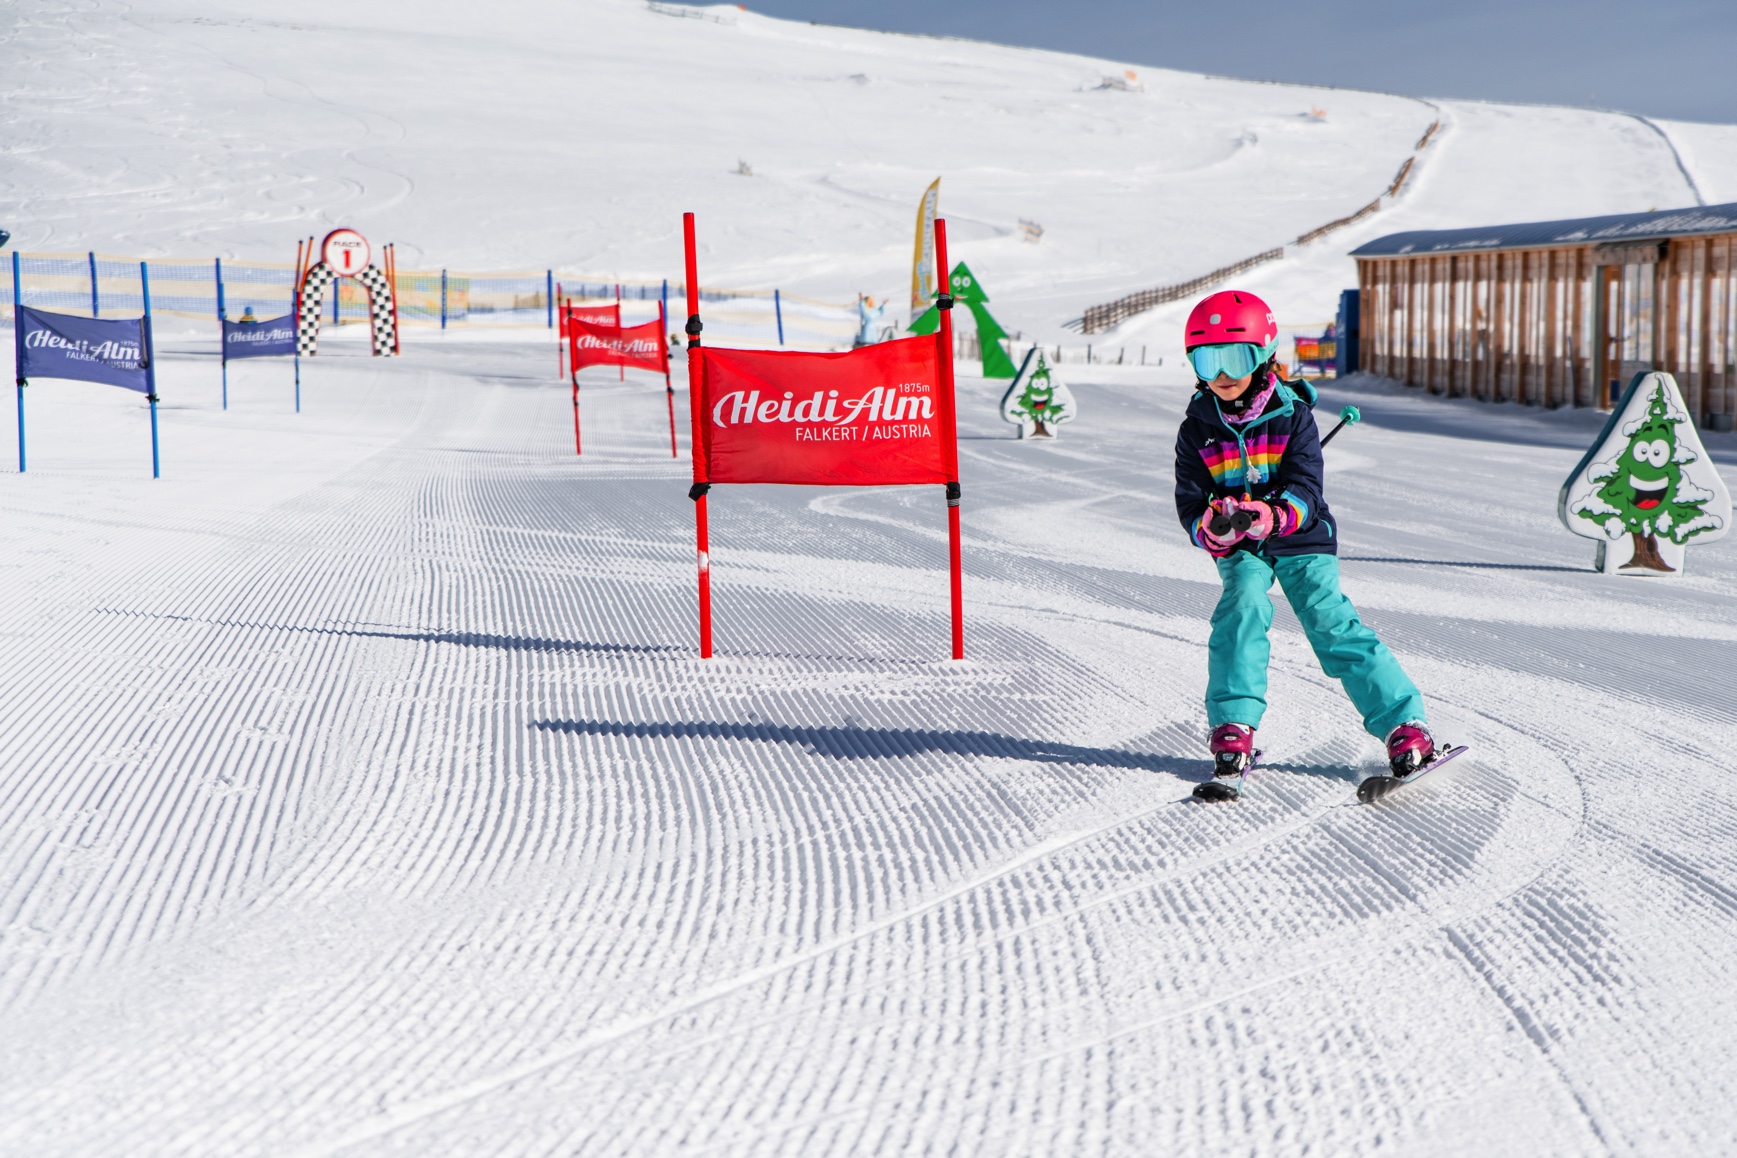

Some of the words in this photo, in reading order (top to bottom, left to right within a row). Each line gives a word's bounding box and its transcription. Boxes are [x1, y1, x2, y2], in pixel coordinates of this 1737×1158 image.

[343, 249, 351, 269] 1
[899, 383, 930, 393] 1875m
[795, 427, 859, 442] FALKERT
[872, 424, 932, 440] AUSTRIA
